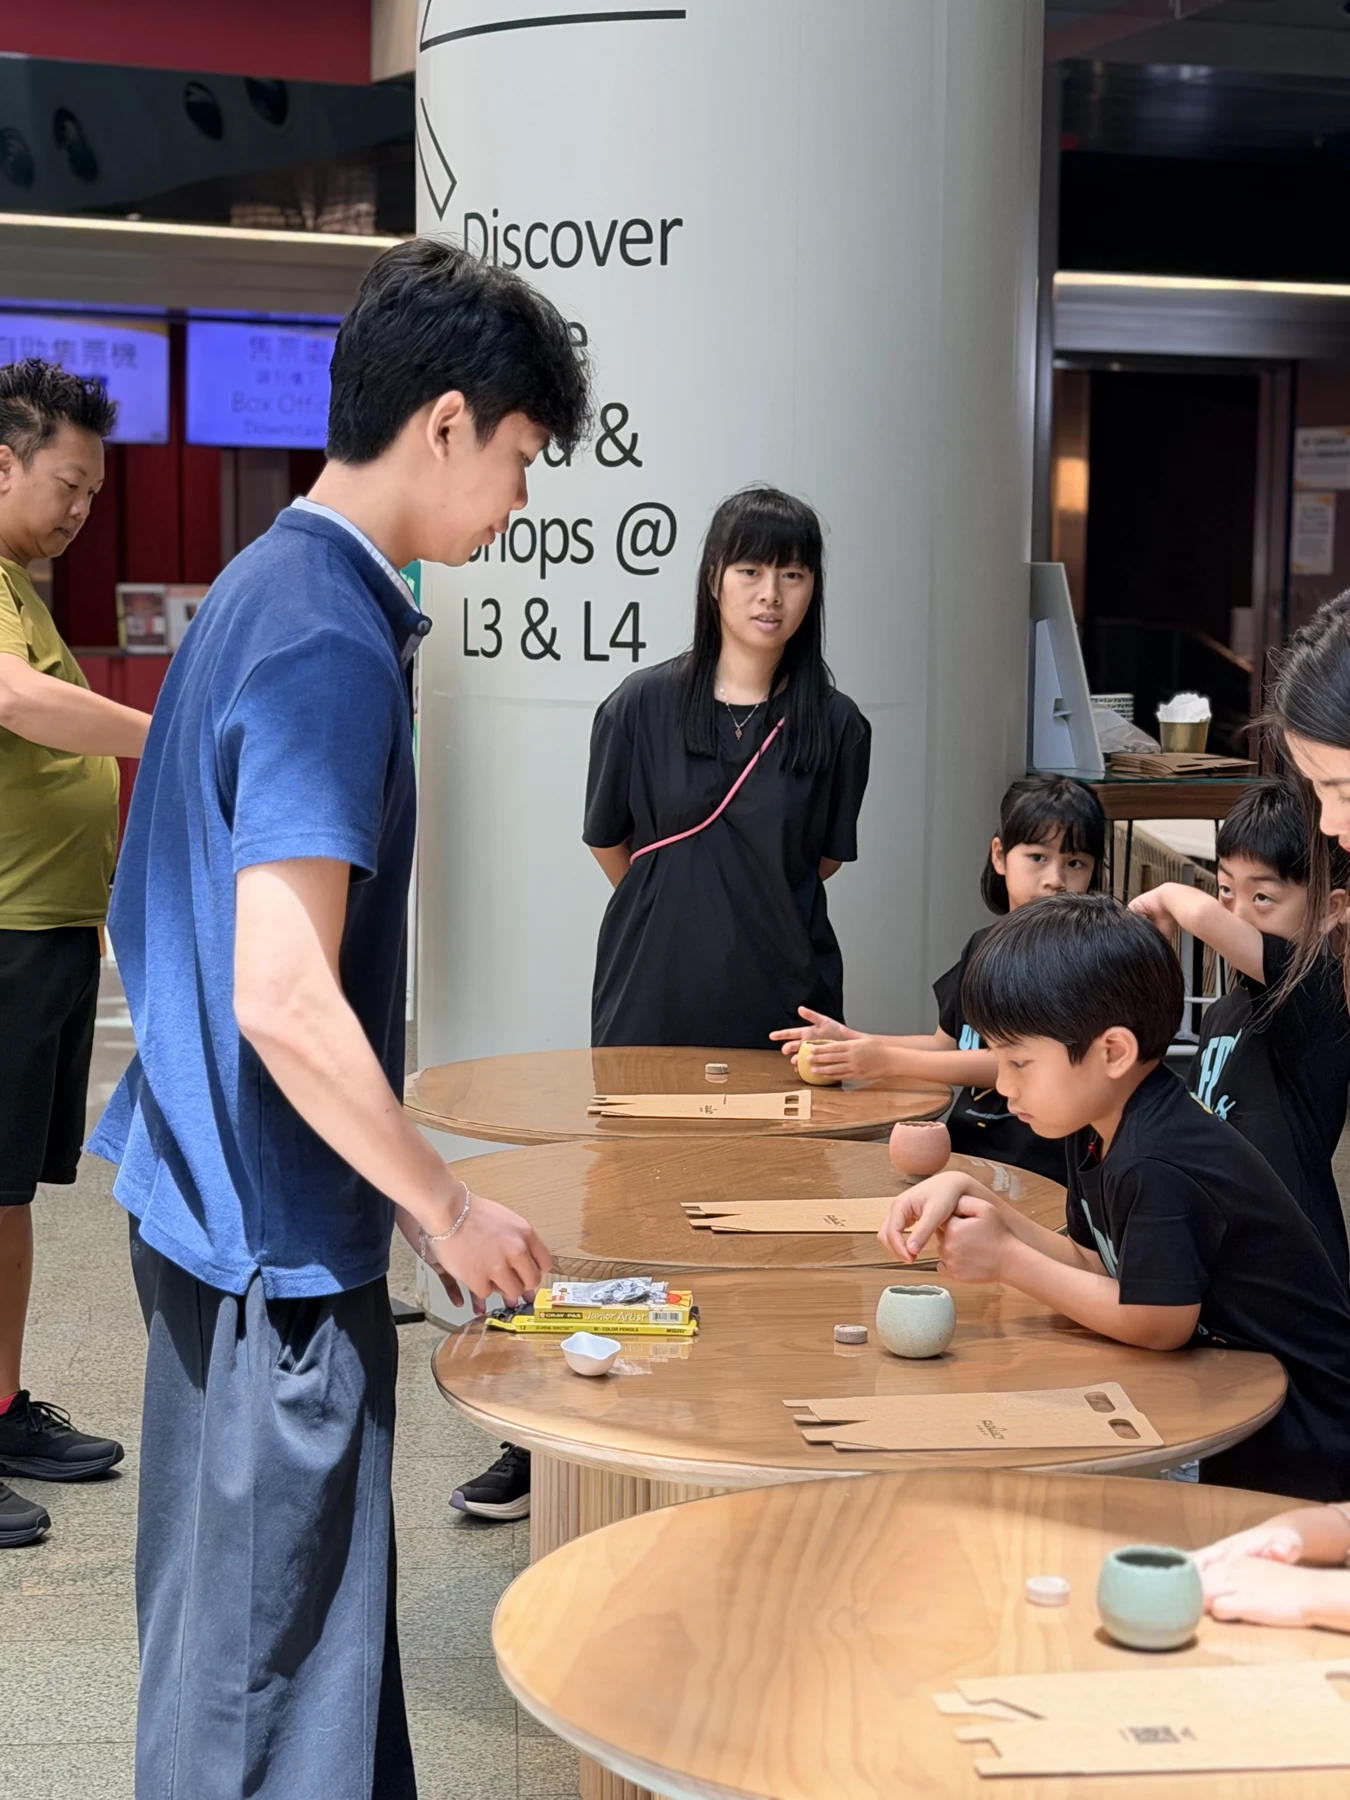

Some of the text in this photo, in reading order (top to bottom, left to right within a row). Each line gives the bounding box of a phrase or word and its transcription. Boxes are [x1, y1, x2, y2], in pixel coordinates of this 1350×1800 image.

[463, 207, 684, 270] Discover
[231, 391, 330, 417] Box Offic
[594, 402, 644, 468] &
[467, 501, 678, 580] ops @
[462, 597, 647, 662] L3 & L4
[584, 1311, 648, 1322] Junior Artist
